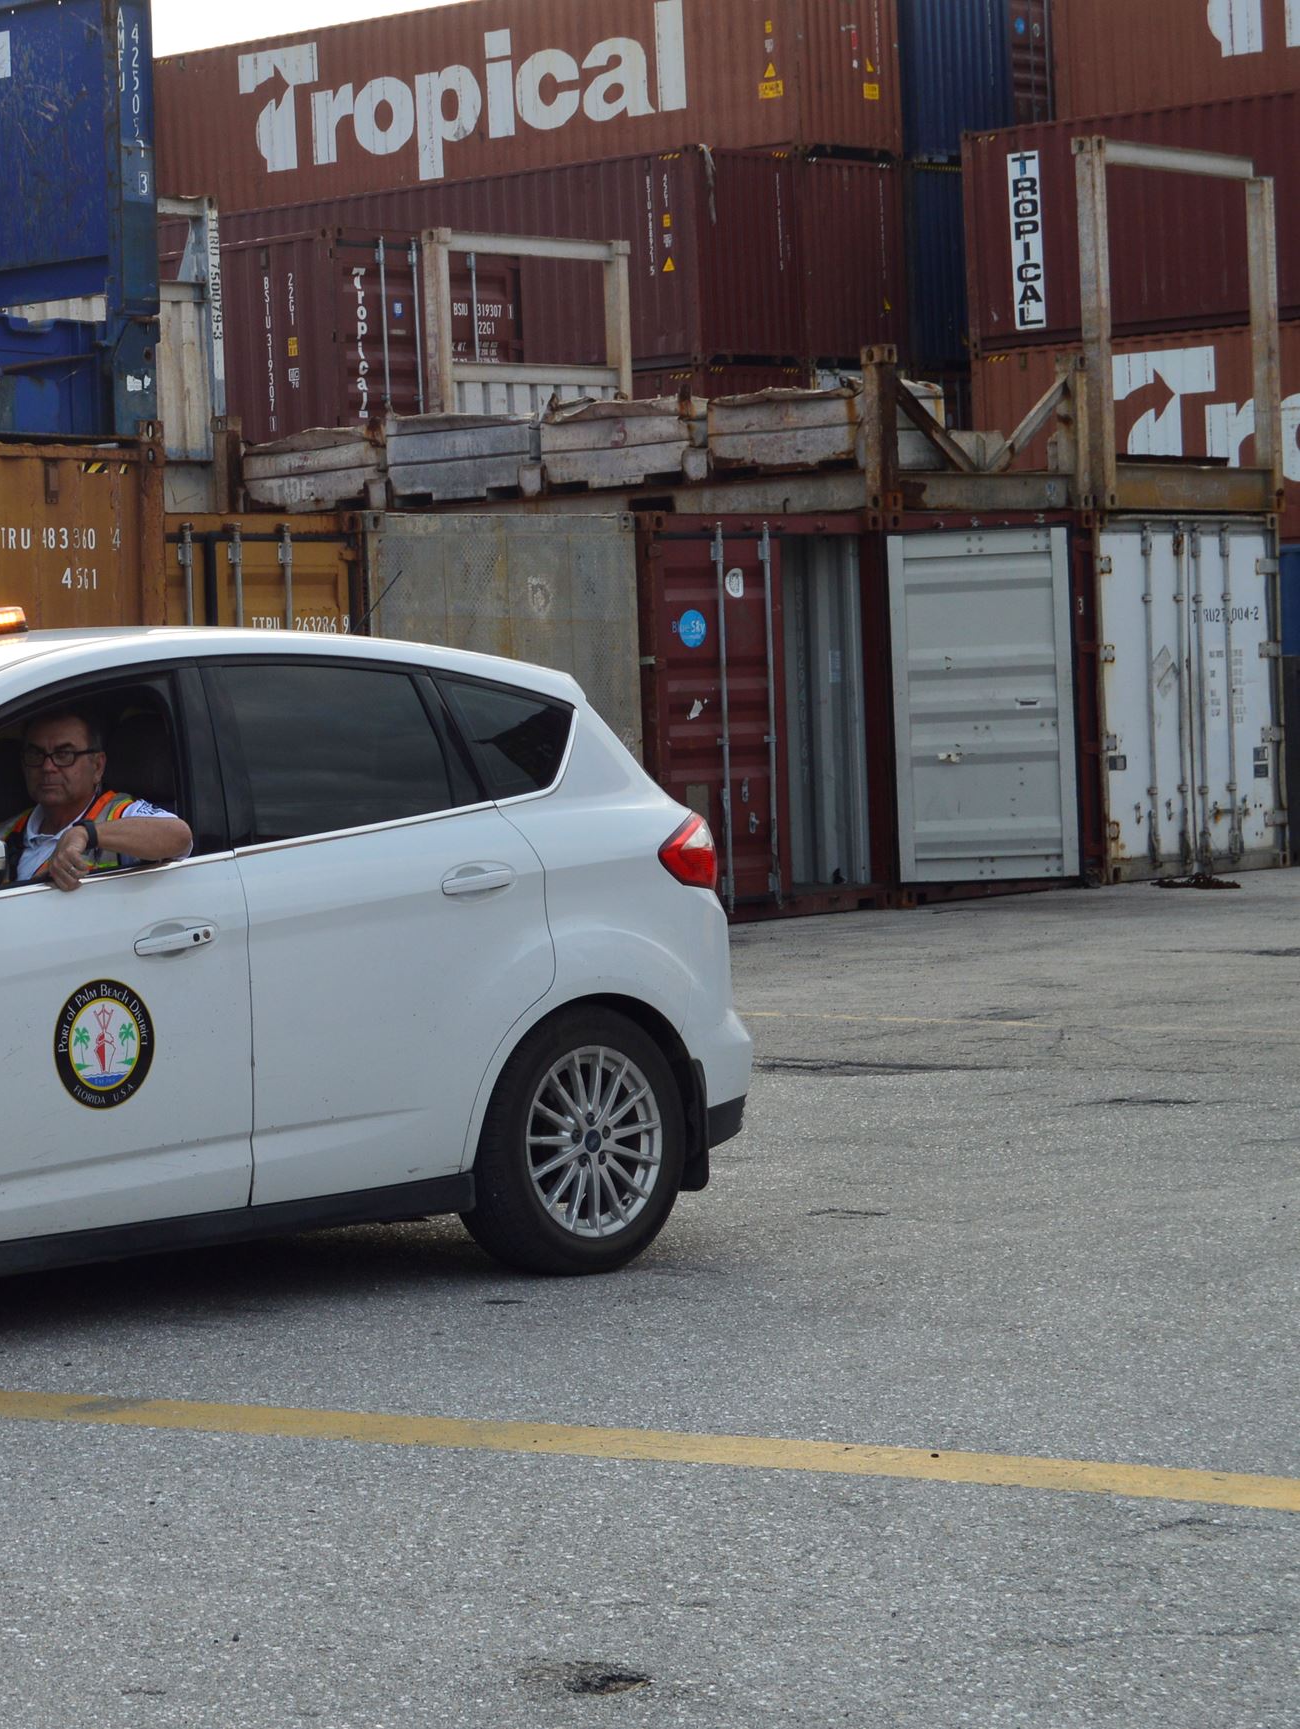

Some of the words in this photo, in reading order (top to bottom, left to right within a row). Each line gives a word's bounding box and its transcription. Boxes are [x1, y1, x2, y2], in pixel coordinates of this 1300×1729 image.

[116, 7, 126, 92] AMFU
[238, 0, 688, 181] Tropical
[1012, 153, 1044, 327] TROPICAL
[263, 276, 272, 329] BSIU
[352, 267, 369, 410] Tropical
[453, 302, 468, 316] BSIU
[476, 303, 502, 318] 319307
[266, 333, 275, 411] 319307
[42, 527, 96, 549] 483360
[73, 1084, 106, 1104] FLORIDA
